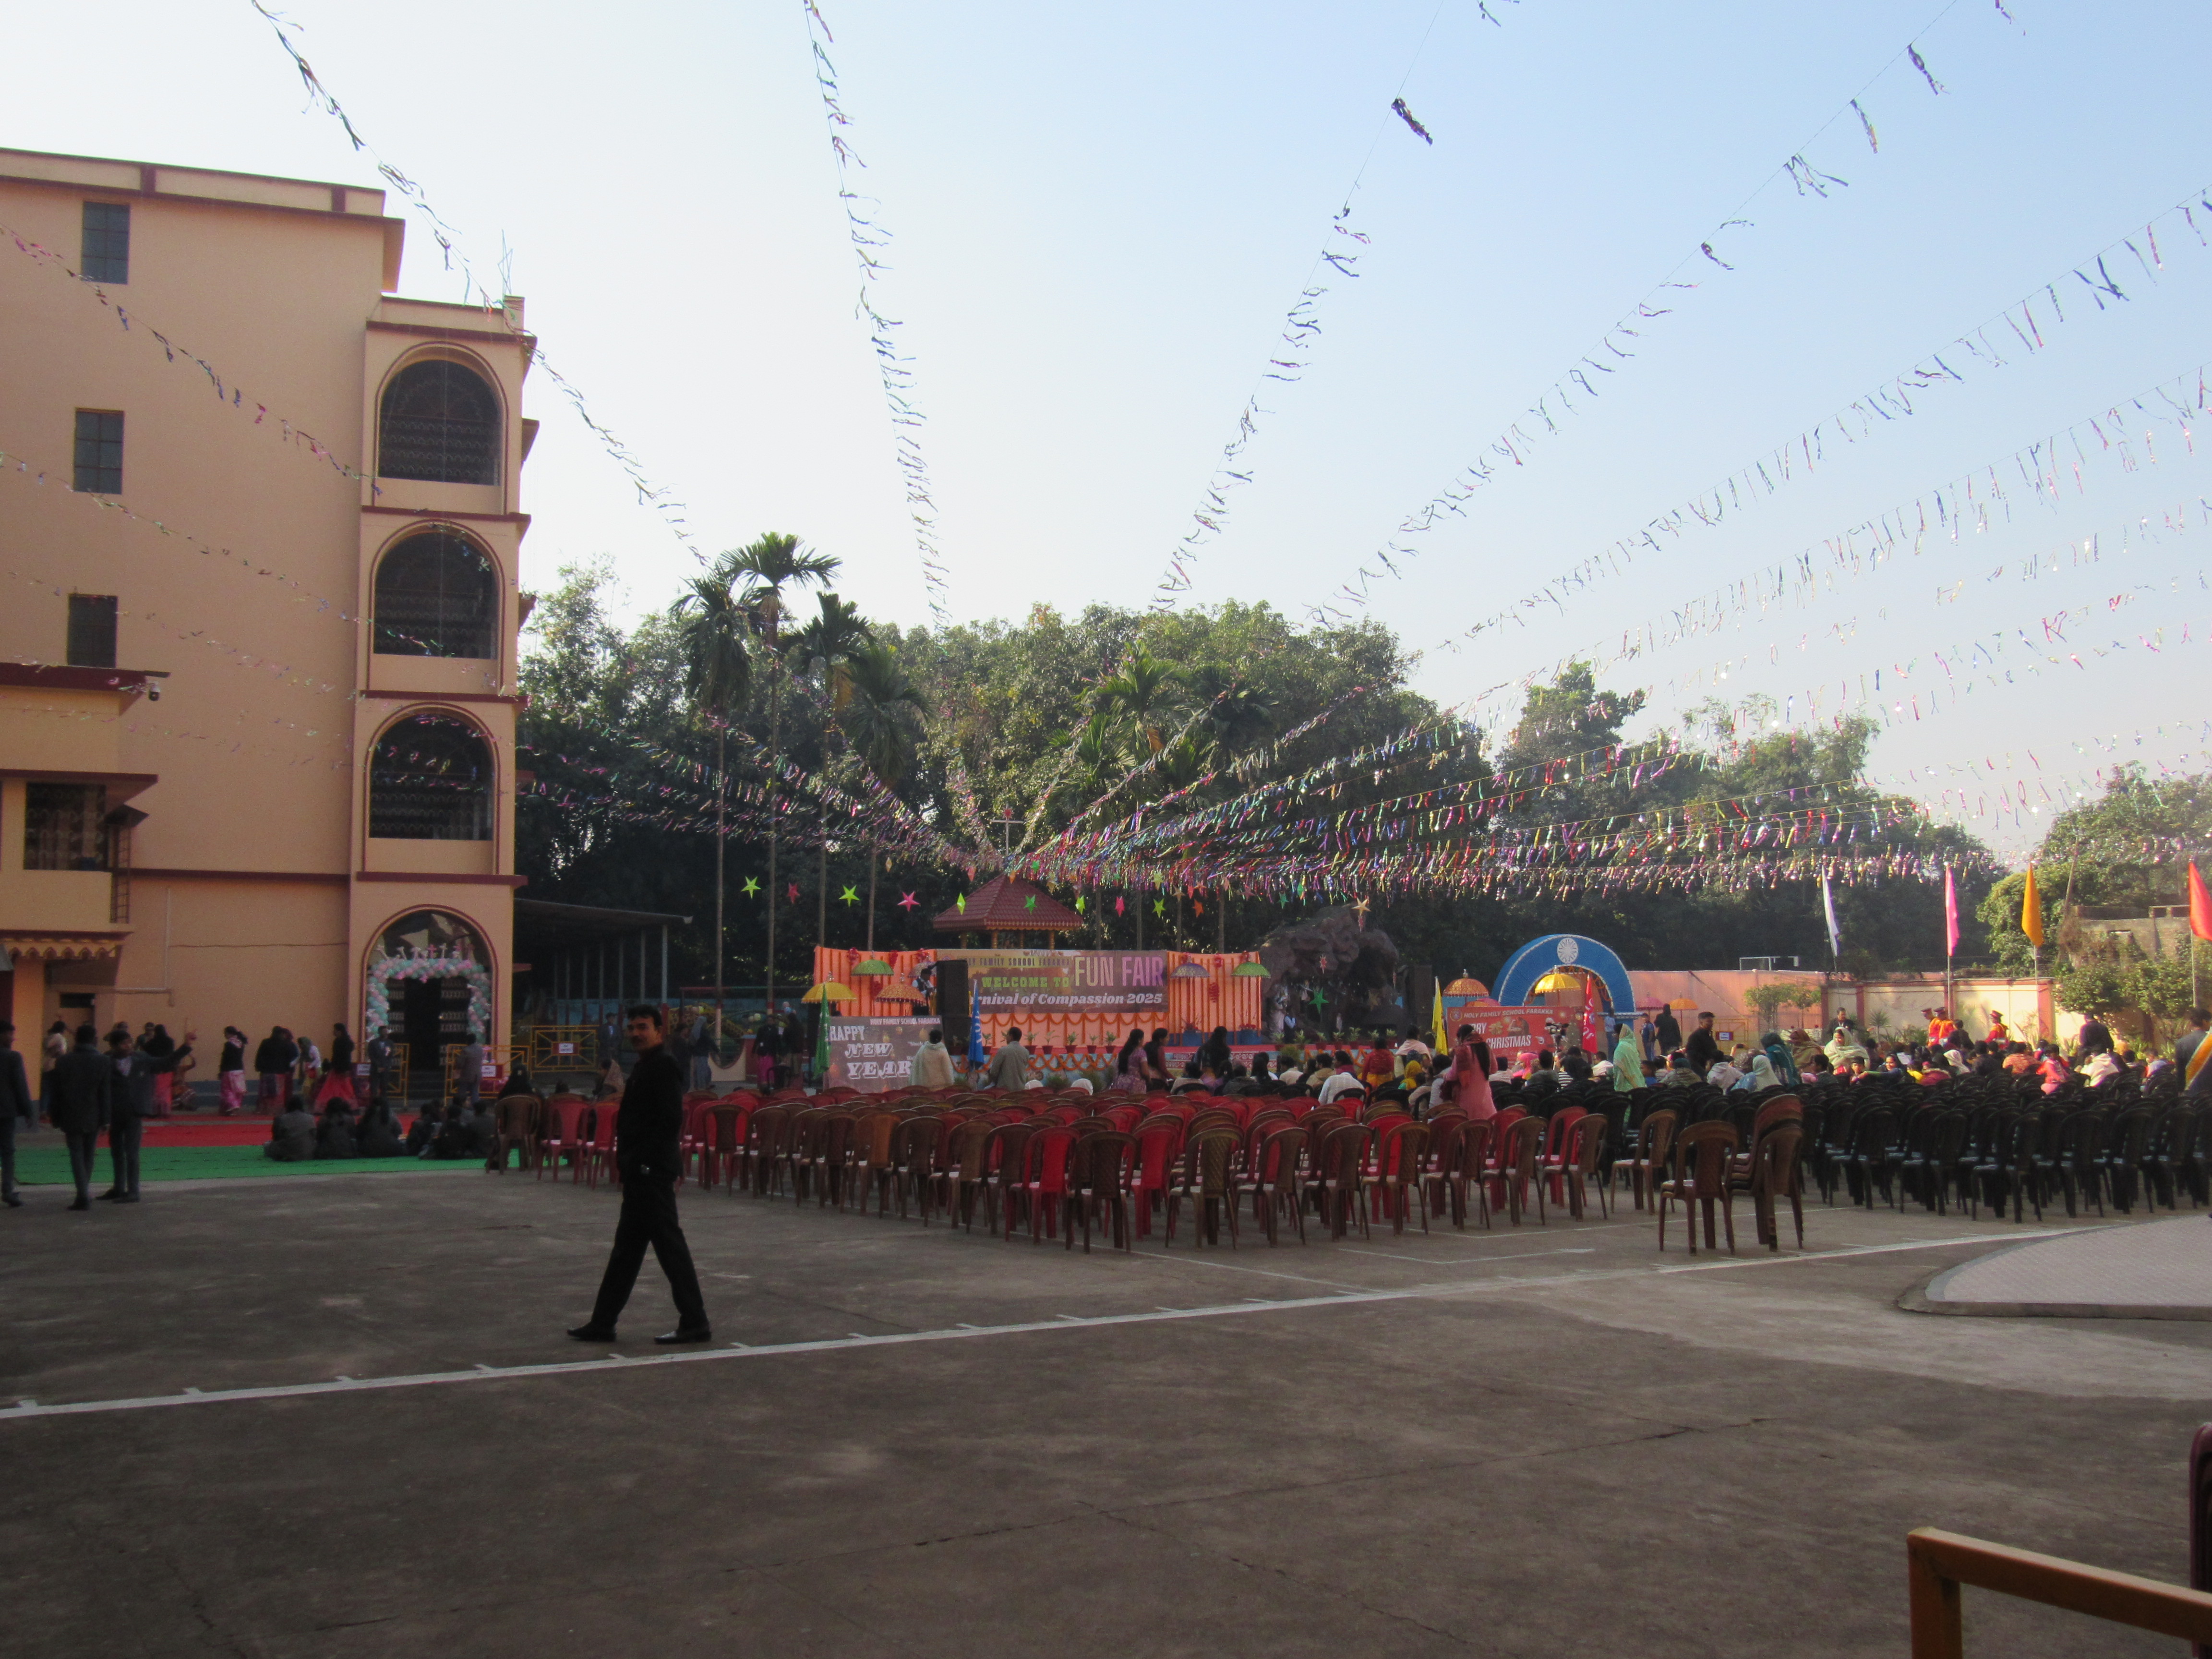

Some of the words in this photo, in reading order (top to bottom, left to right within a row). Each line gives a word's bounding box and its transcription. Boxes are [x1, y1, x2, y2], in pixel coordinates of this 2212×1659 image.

[980, 958, 1004, 966] FAMILY
[1009, 958, 1034, 966] SCHOOL
[1075, 957, 1114, 986] FUN
[1122, 957, 1164, 987] FAIR
[982, 977, 1047, 987] WELCOME
[1053, 977, 1070, 987] TO
[1021, 993, 1038, 1005] of
[1038, 993, 1124, 1007] Compassion
[1126, 993, 1163, 1004] 2025
[830, 1025, 865, 1041] HAPPY
[1486, 1035, 1531, 1049] CHRISTMAS
[844, 1043, 894, 1058] NEW
[847, 1060, 913, 1080] YEAR
